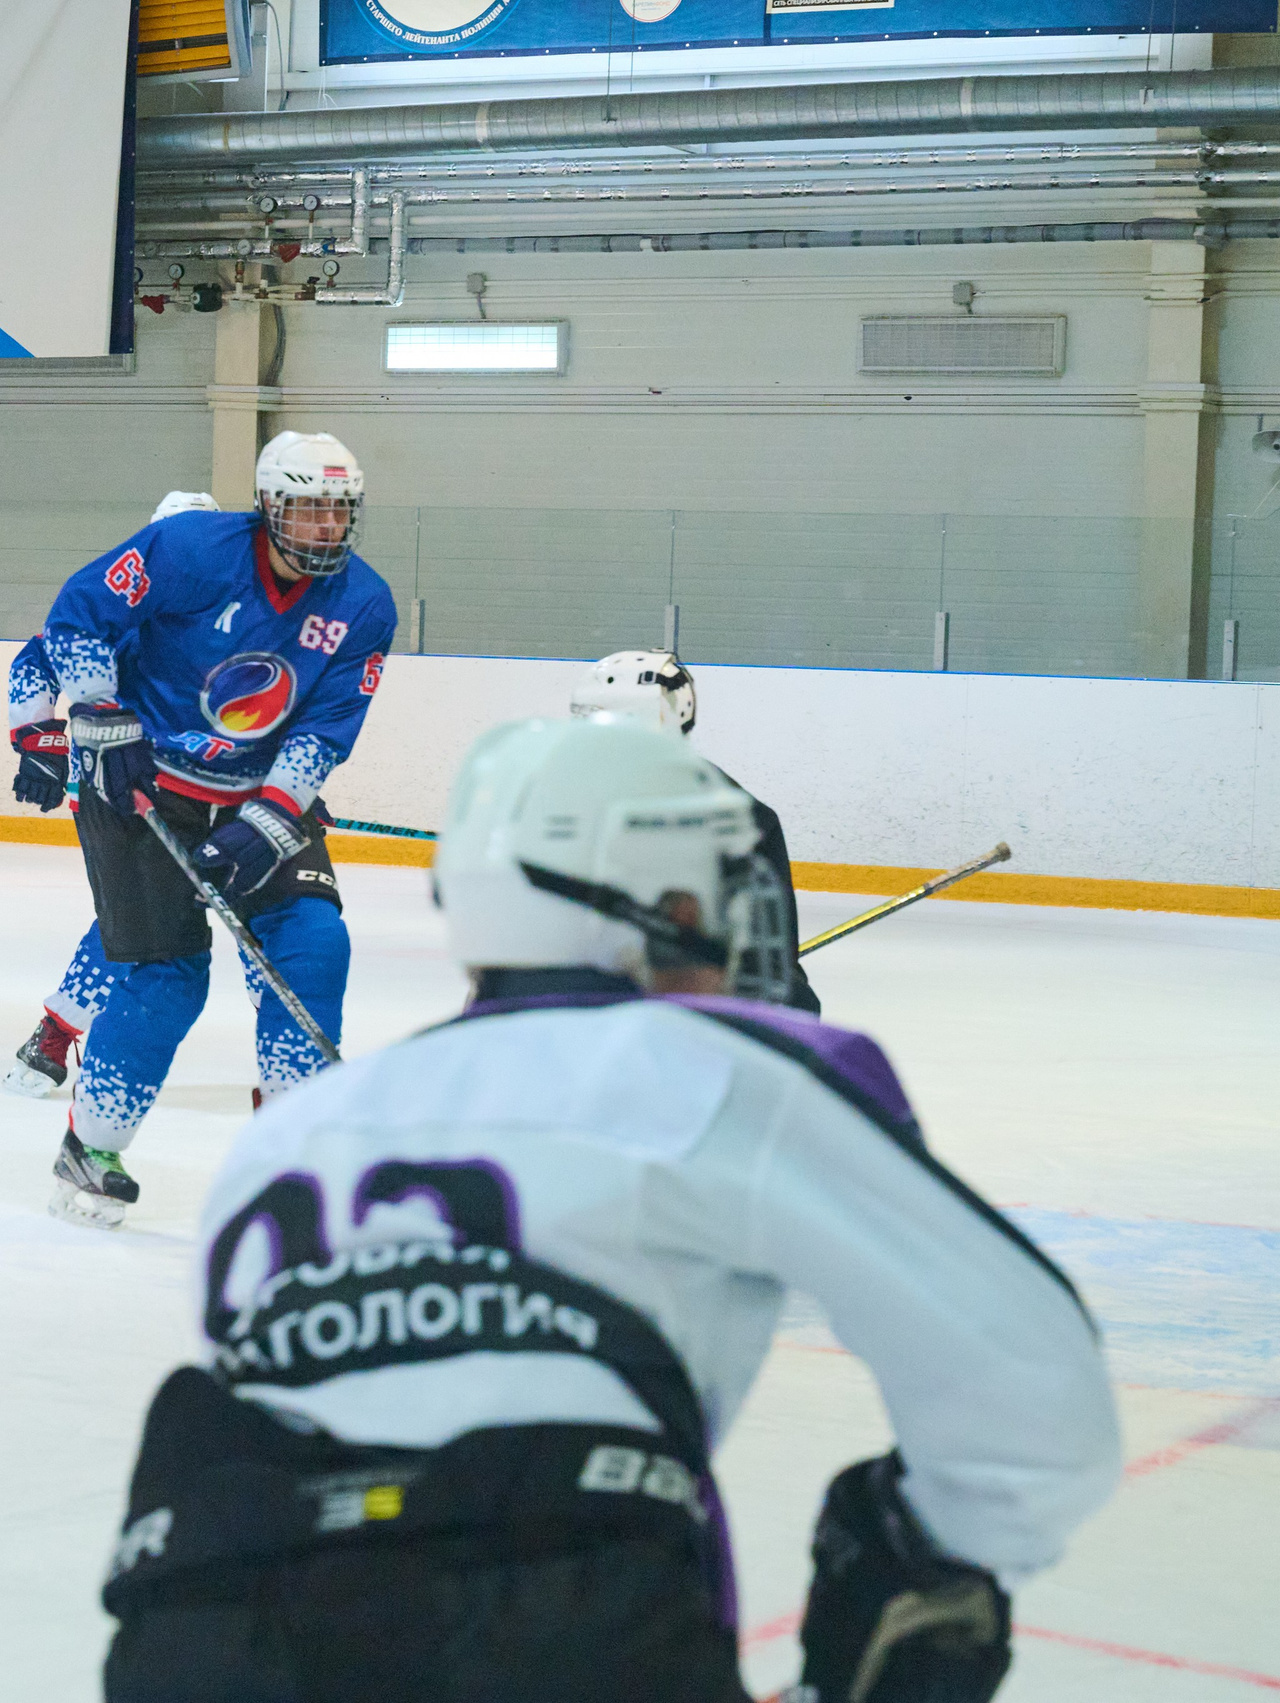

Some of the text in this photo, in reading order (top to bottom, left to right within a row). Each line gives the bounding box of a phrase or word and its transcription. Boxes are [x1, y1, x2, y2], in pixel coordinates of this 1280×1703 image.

[403, 32, 461, 45] ЛЕЙТЕНАНТА
[461, 4, 504, 39] ПОЛИЦИИ
[299, 614, 349, 656] 69
[296, 869, 339, 891] CC
